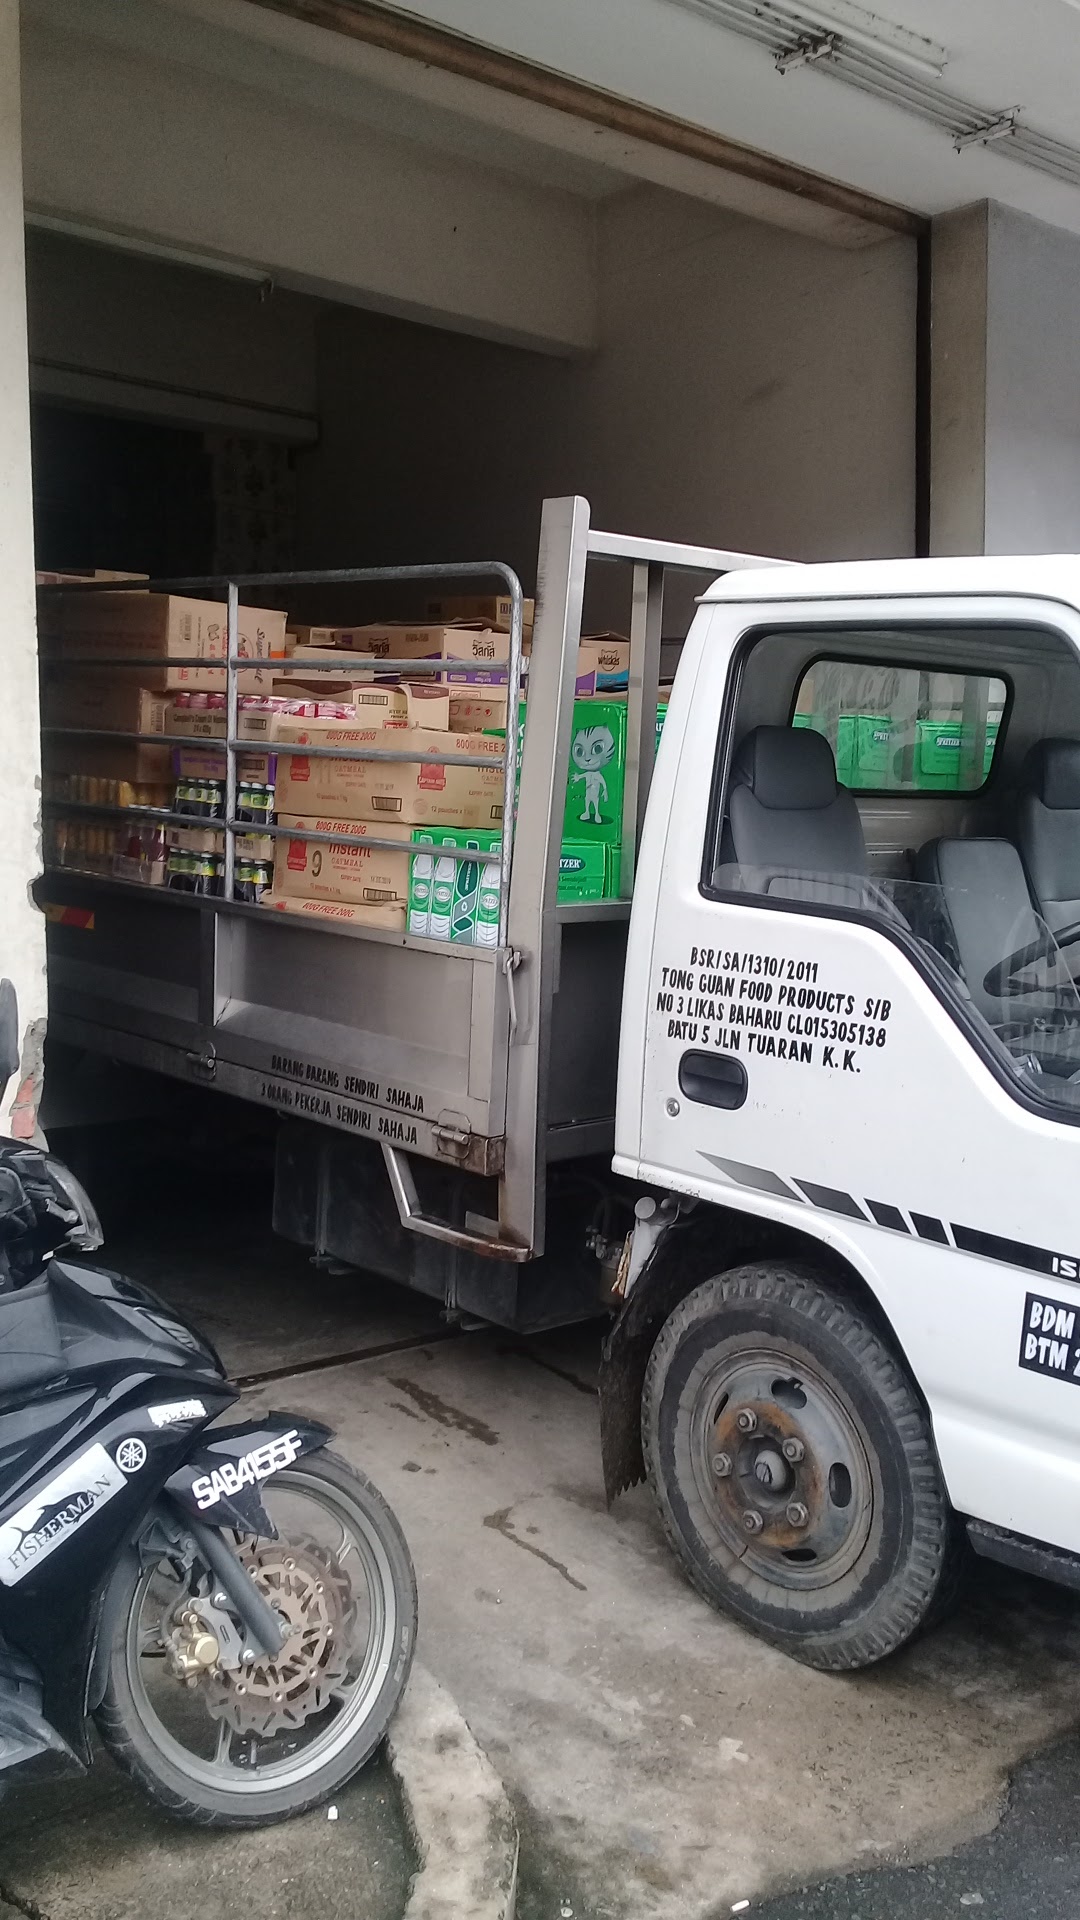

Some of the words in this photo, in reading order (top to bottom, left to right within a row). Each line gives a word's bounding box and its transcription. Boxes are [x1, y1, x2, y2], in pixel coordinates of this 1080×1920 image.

[342, 732, 360, 741] FREE
[477, 741, 499, 752] FREE
[332, 822, 350, 833] FREE
[350, 825, 367, 835] 200G
[311, 850, 322, 877] 9
[691, 947, 818, 983] BSR/SA/1310/2011
[662, 967, 694, 992] TONG
[698, 974, 736, 998] GUAN
[739, 979, 773, 1003] FOOD
[777, 985, 854, 1016] PRODUCTS
[864, 997, 892, 1021] S/B
[656, 991, 674, 1013] NO
[676, 993, 685, 1014] 3
[686, 998, 725, 1021] LIKAS
[728, 1003, 783, 1032] BAHARU
[787, 1013, 887, 1048] CL015305138
[667, 1018, 698, 1042] BATU
[700, 1025, 710, 1044] 5
[714, 1027, 741, 1051] JLN
[747, 1032, 814, 1064] TUARAN
[271, 1054, 304, 1078] BARANG
[305, 1064, 339, 1088] BARANG
[344, 1076, 379, 1099] SENDIRI
[386, 1088, 424, 1113] SAHAJA
[266, 1084, 294, 1106] ORANG
[295, 1092, 332, 1118] PEKERJA
[336, 1104, 372, 1130] SENDIRI
[378, 1117, 417, 1144] SAHAJA
[1029, 1300, 1076, 1340] BDM
[1025, 1333, 1069, 1370] BTM
[191, 1429, 302, 1510] SAB4155F
[7, 1473, 111, 1570] FISHERMAN
